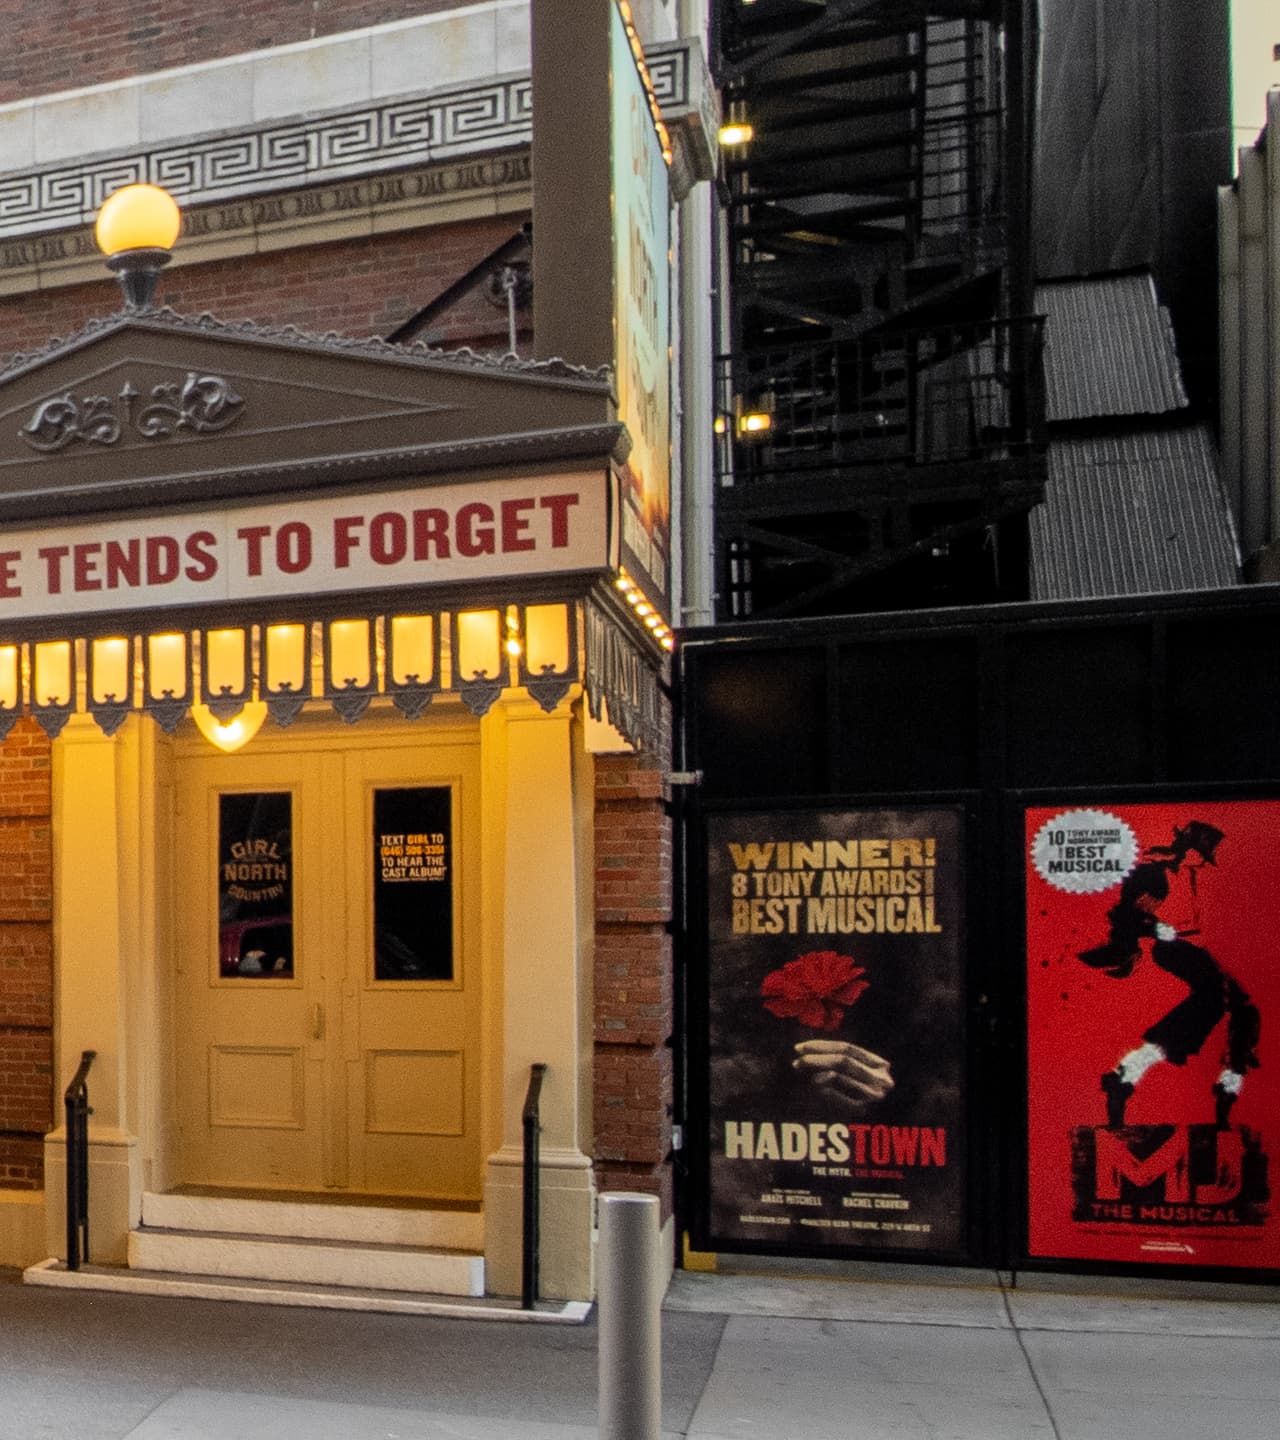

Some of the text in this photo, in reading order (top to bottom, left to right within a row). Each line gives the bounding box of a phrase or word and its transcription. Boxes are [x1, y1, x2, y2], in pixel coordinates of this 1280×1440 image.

[38, 530, 218, 595] TENDS
[237, 522, 313, 576] TO
[333, 493, 581, 566] FORGET
[381, 833, 444, 846] TEXT GIRL TO
[1048, 830, 1065, 846] 10
[230, 839, 280, 859] GIRL
[728, 838, 937, 870] WINNER!
[1065, 845, 1106, 859] BEST
[382, 856, 444, 867] TO HEAR THE
[1048, 859, 1124, 873] MUSICAL
[224, 863, 287, 880] NORTH
[382, 867, 406, 878] CAST
[227, 883, 283, 901] COUNTRY
[732, 872, 748, 898] 8
[753, 871, 816, 897] TONY
[732, 896, 942, 935] BEST MUSICAL
[725, 1121, 947, 1167] HADESTOWN
[786, 1195, 822, 1207] MITCHELL
[843, 1197, 872, 1208] RACHEL
[1091, 1203, 1240, 1223] THE MUSICAL
